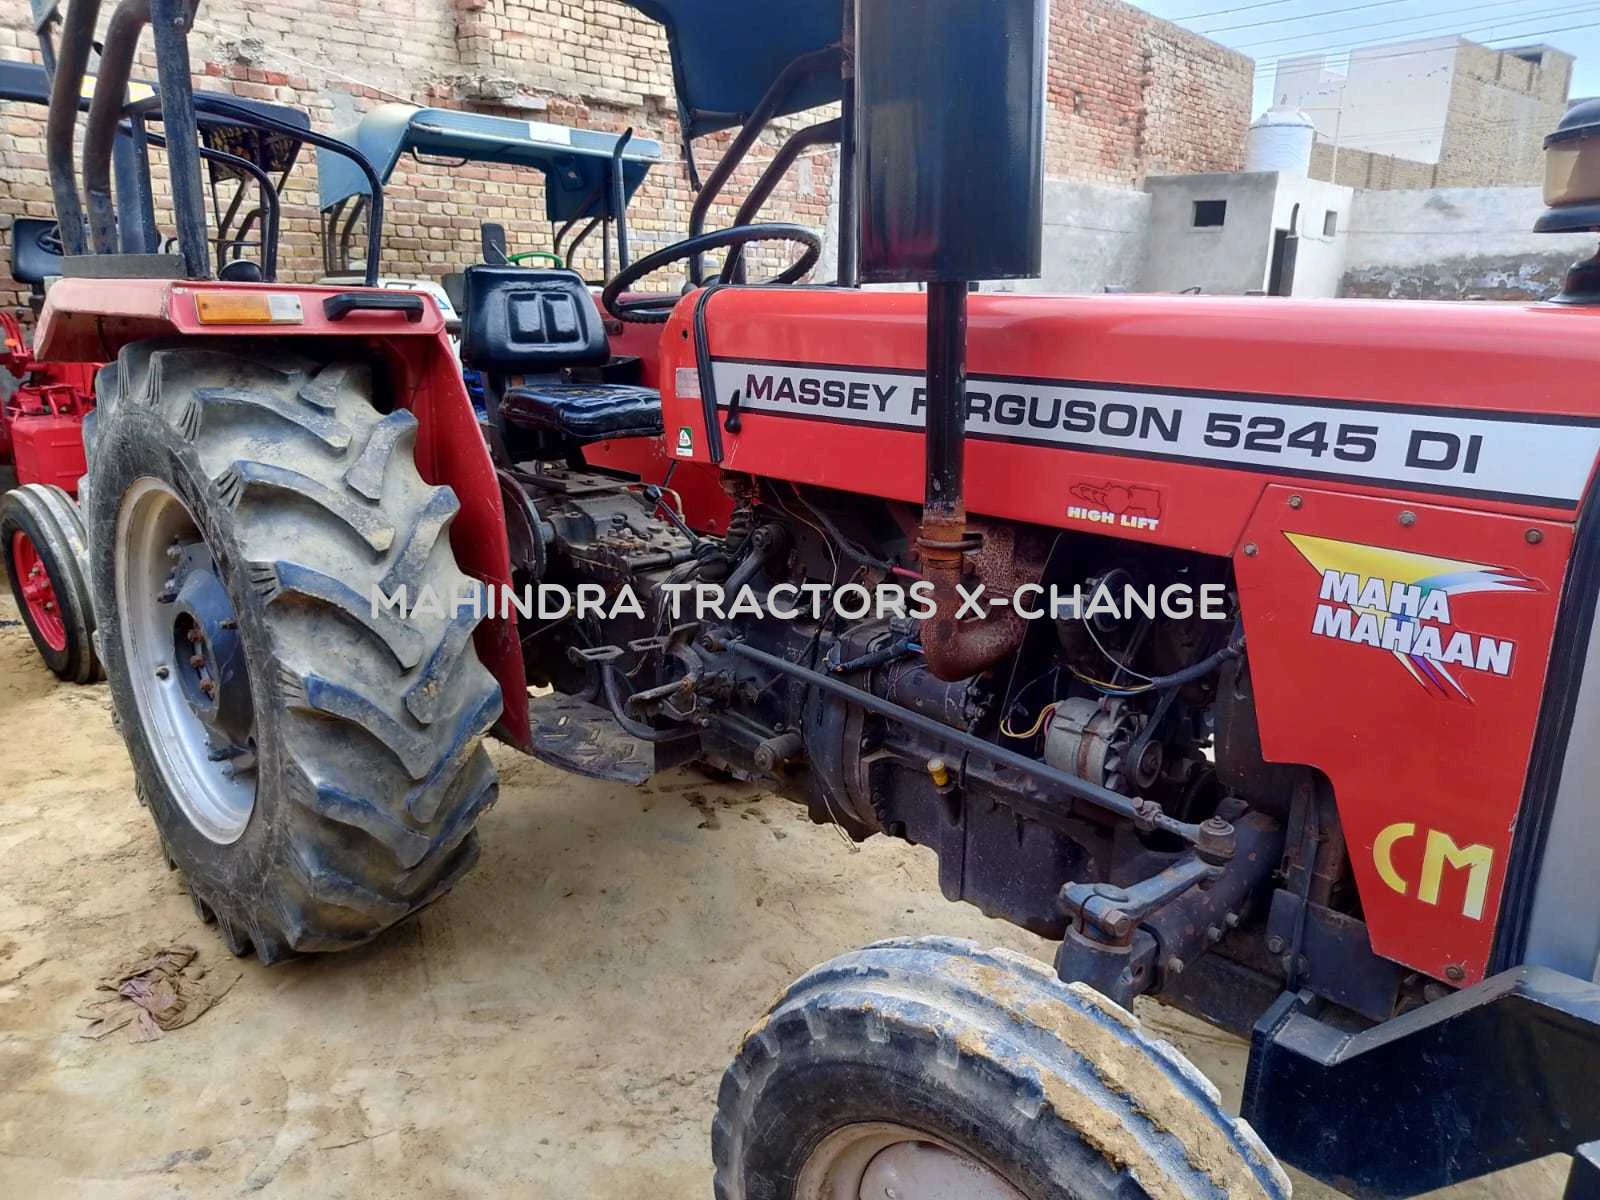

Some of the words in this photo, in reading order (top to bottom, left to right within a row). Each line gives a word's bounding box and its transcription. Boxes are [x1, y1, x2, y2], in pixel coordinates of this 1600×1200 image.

[745, 374, 898, 416] MASSEY
[910, 387, 1183, 442] FRGUSON
[1202, 412, 1380, 463] 5245
[1404, 429, 1484, 474] DI
[1066, 506, 1115, 525] HIGH
[1120, 514, 1160, 531] LIFT
[1318, 569, 1452, 625] MAHA
[1311, 603, 1515, 678] MAHAAN
[1372, 822, 1494, 921] CM
